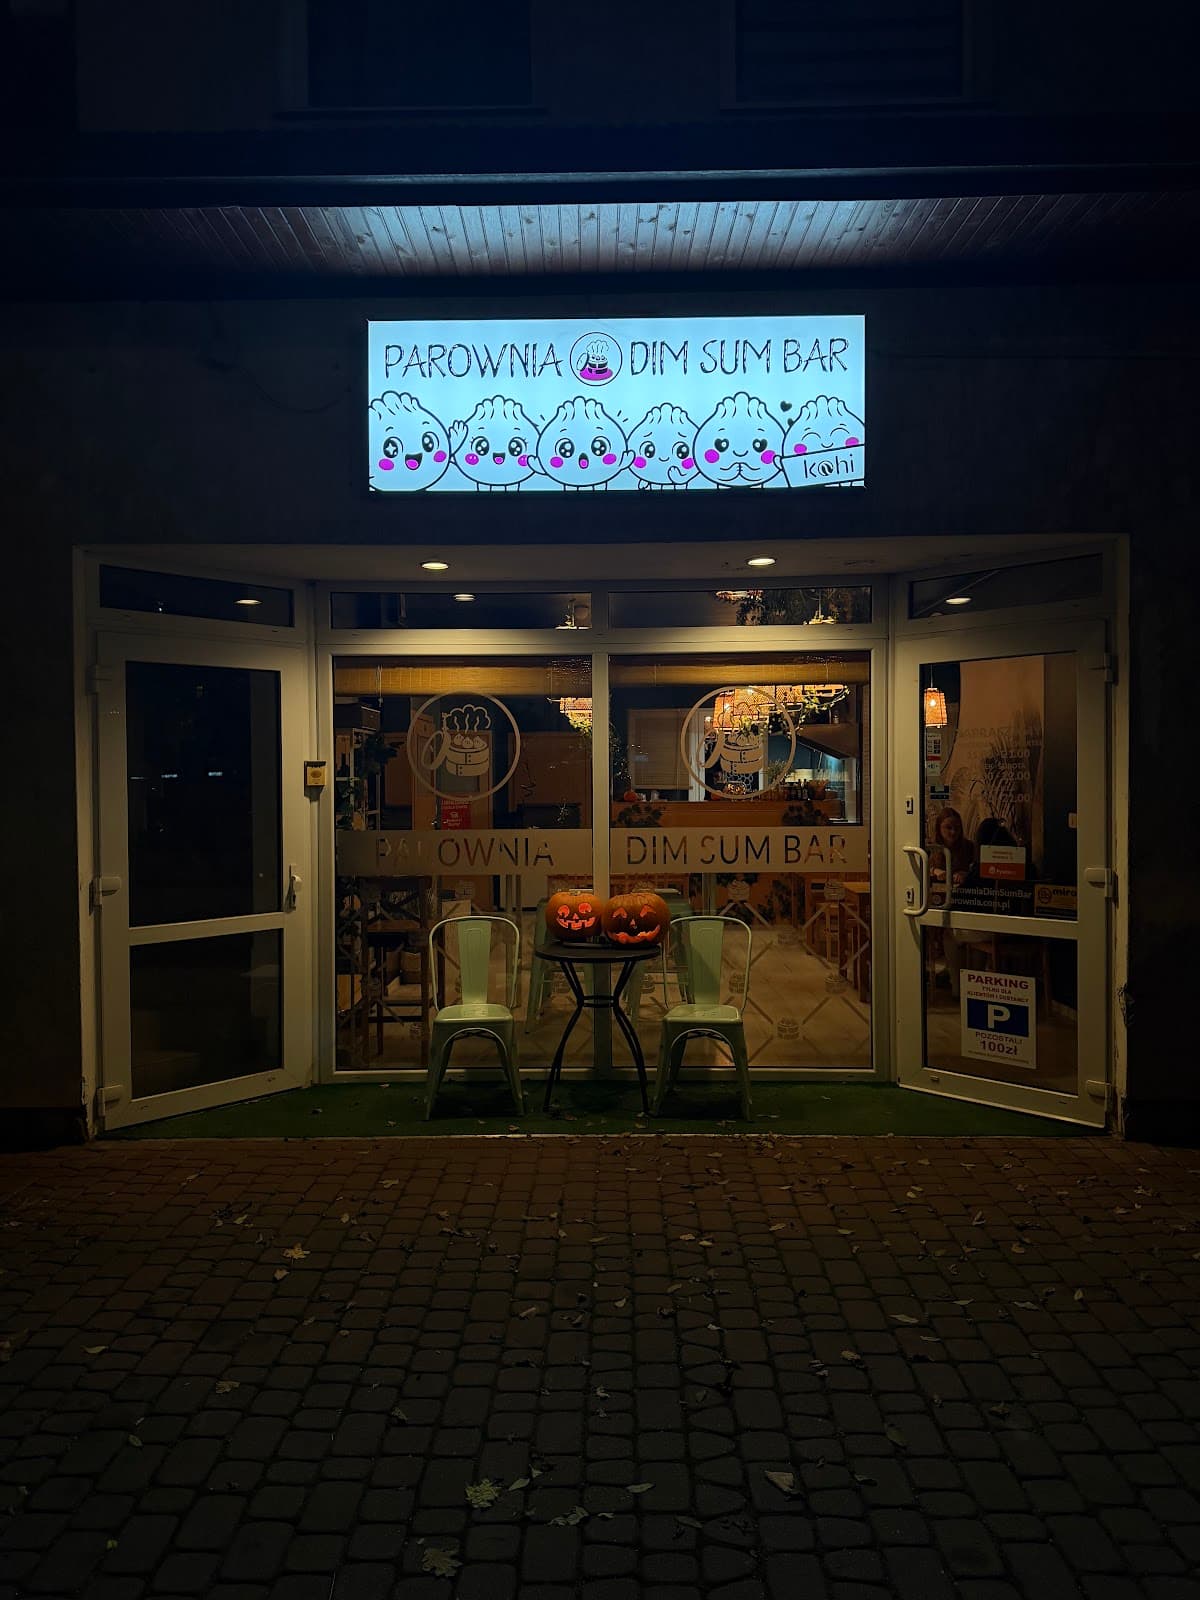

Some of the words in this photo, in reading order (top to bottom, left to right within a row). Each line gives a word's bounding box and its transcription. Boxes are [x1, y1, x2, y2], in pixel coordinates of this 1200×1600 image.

[384, 342, 563, 379] PAROWNIA
[631, 340, 688, 376] DIM
[700, 338, 772, 375] SUM
[783, 337, 850, 374] BAR
[626, 835, 688, 865] DIM
[701, 835, 770, 865] SUM
[784, 834, 848, 864] BAR
[968, 973, 1029, 990] PARKING
[987, 1003, 1012, 1030] P
